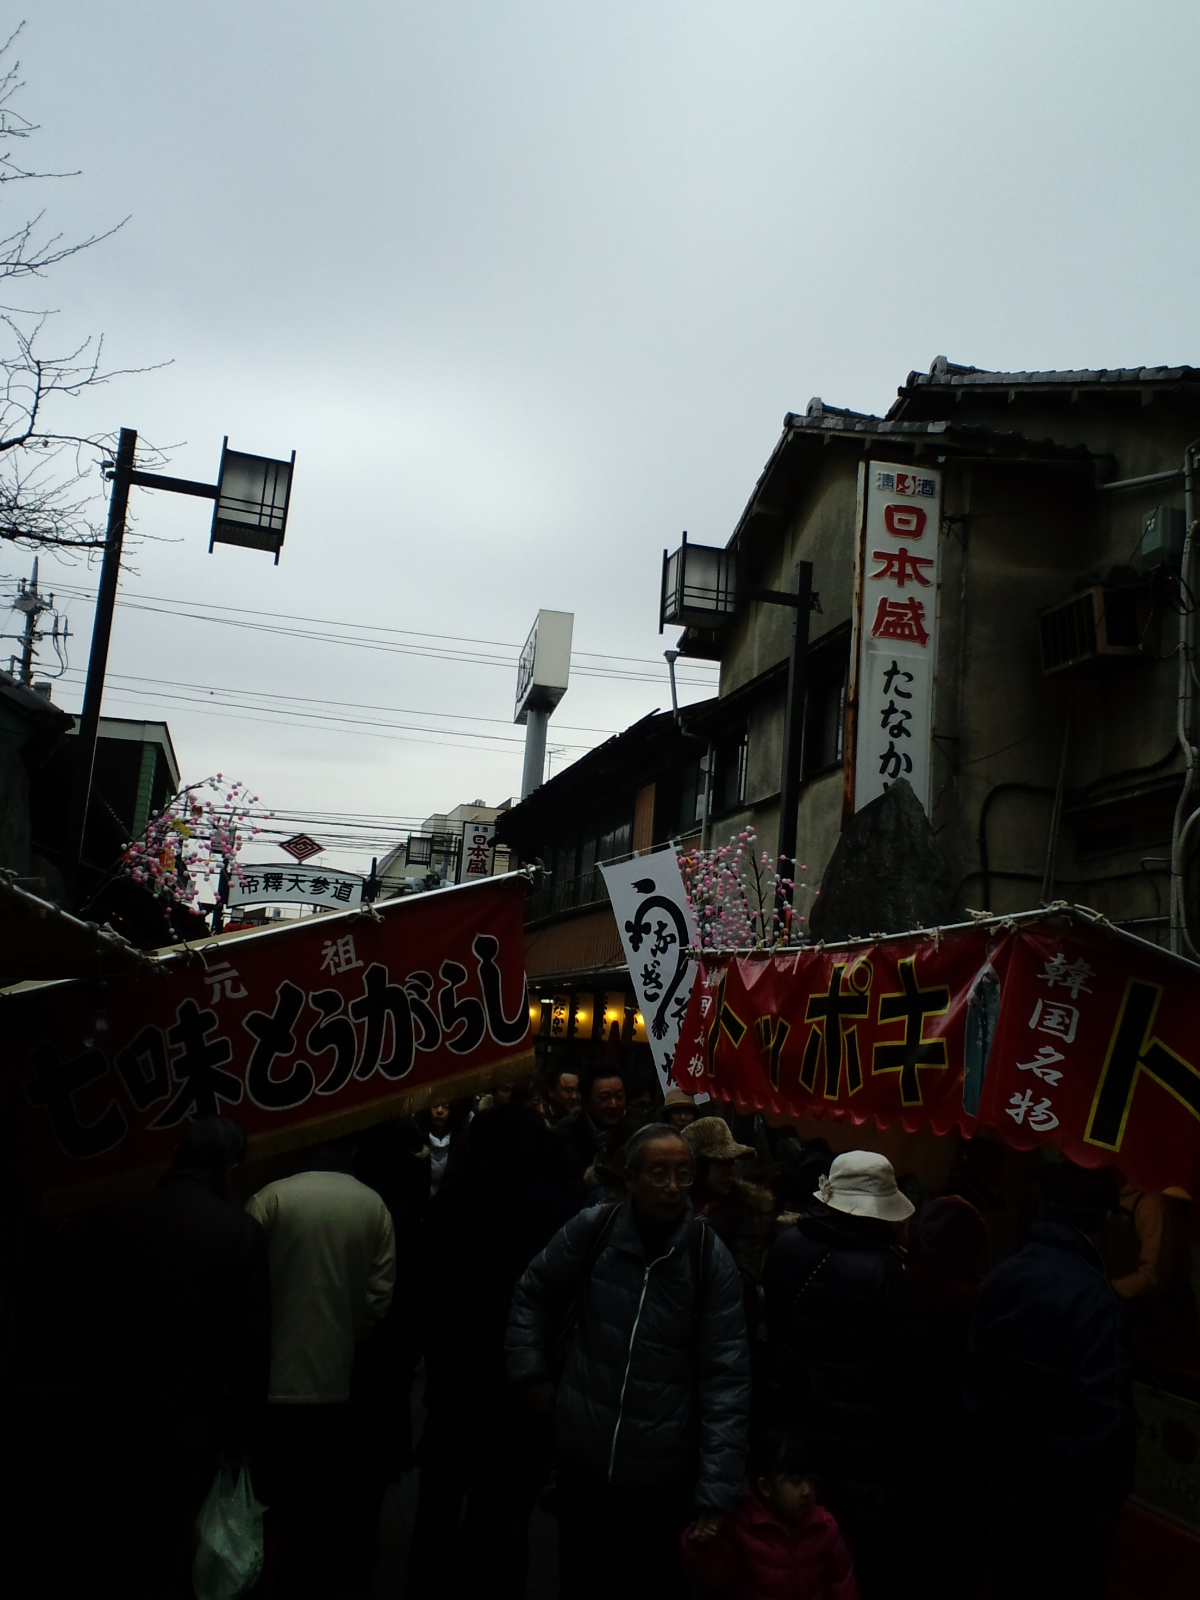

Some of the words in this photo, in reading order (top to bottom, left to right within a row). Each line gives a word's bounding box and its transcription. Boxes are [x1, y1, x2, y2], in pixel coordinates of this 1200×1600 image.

[870, 503, 935, 648] 日本盛
[878, 660, 914, 793] たなか
[467, 834, 490, 875] 日本盛
[203, 934, 365, 1004] 元祖
[25, 933, 530, 1160] 七味とうがらし
[1005, 952, 1098, 1132] 韓国名物
